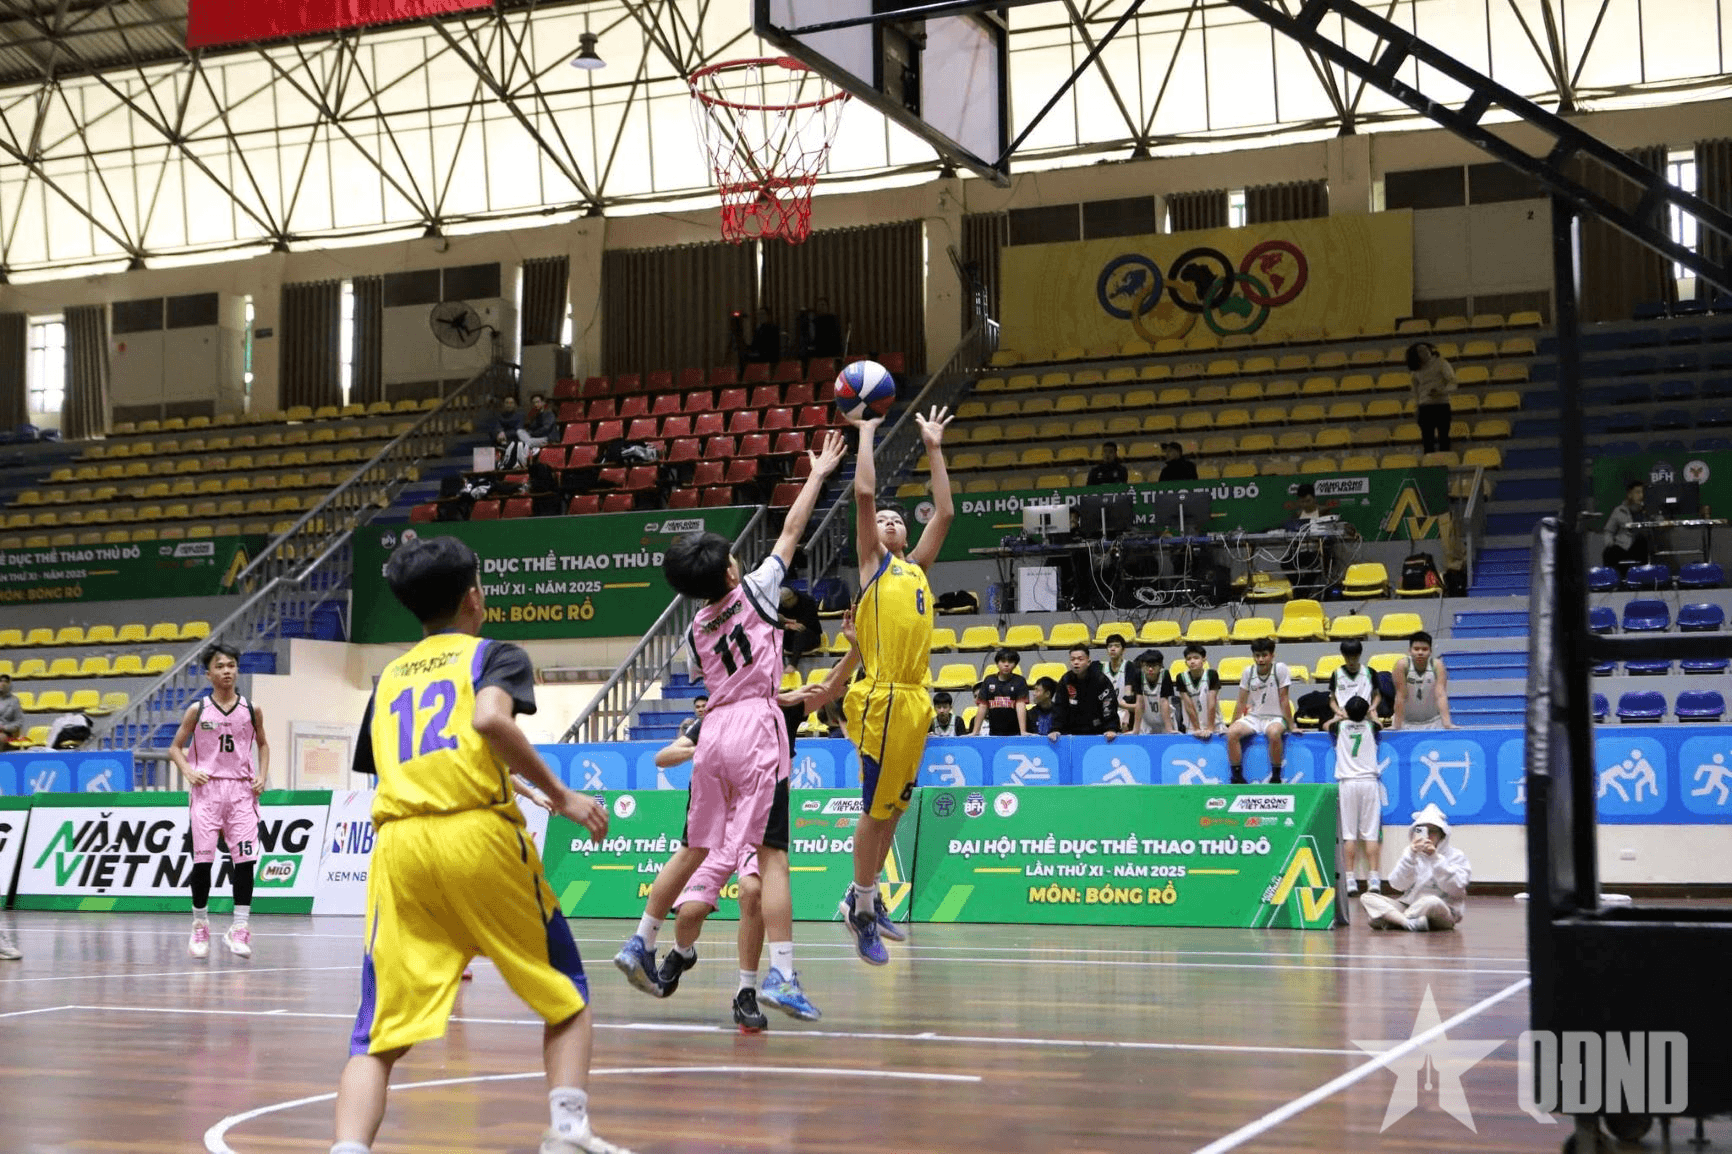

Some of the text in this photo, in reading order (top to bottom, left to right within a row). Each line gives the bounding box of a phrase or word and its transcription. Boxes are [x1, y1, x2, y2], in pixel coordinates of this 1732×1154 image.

[962, 499, 992, 517] ĐẠI
[994, 495, 1024, 515] HỘI
[1232, 481, 1260, 499] ĐÔ
[8, 552, 34, 568] DỤC
[34, 546, 59, 564] THỂ
[60, 550, 95, 562] THAO
[96, 544, 121, 560] THỦ
[122, 543, 141, 559] ĐÔ
[483, 558, 520, 578] DỤC
[521, 549, 557, 572] THỂ
[559, 554, 610, 571] THAO
[612, 547, 649, 568] THỦ
[482, 581, 511, 597] THỨ
[512, 583, 526, 596] XI
[535, 580, 567, 595] NĂM
[568, 580, 602, 594] 2025
[510, 602, 564, 622] BÓNG
[566, 595, 595, 621] RỔ
[713, 622, 754, 678] 11
[389, 680, 459, 765] 12
[218, 734, 235, 753] 15
[1349, 732, 1363, 758] 7
[33, 811, 175, 869] NĂNG
[238, 841, 253, 857] 15
[346, 821, 374, 854] NB
[571, 839, 600, 857] ĐẠI
[602, 835, 632, 857] HỘI
[634, 833, 667, 852] THỂ
[793, 834, 828, 853] THỦ
[830, 836, 854, 853] ĐÔ
[949, 832, 1271, 859] ĐẠI HỘI THỂ DỤC THỂ THAO THỦ ĐÔ
[55, 844, 150, 893] VIỆT
[266, 865, 292, 876] MILO
[328, 871, 367, 882] XEM NB
[637, 858, 664, 873] LẦN
[1025, 860, 1054, 876] LẦN
[1057, 862, 1087, 876] THỨ
[1088, 865, 1104, 877] XI
[1113, 862, 1148, 877] NĂM
[1150, 865, 1186, 877] 2025
[1029, 880, 1178, 904] MÔN: BÓNG RỔ
